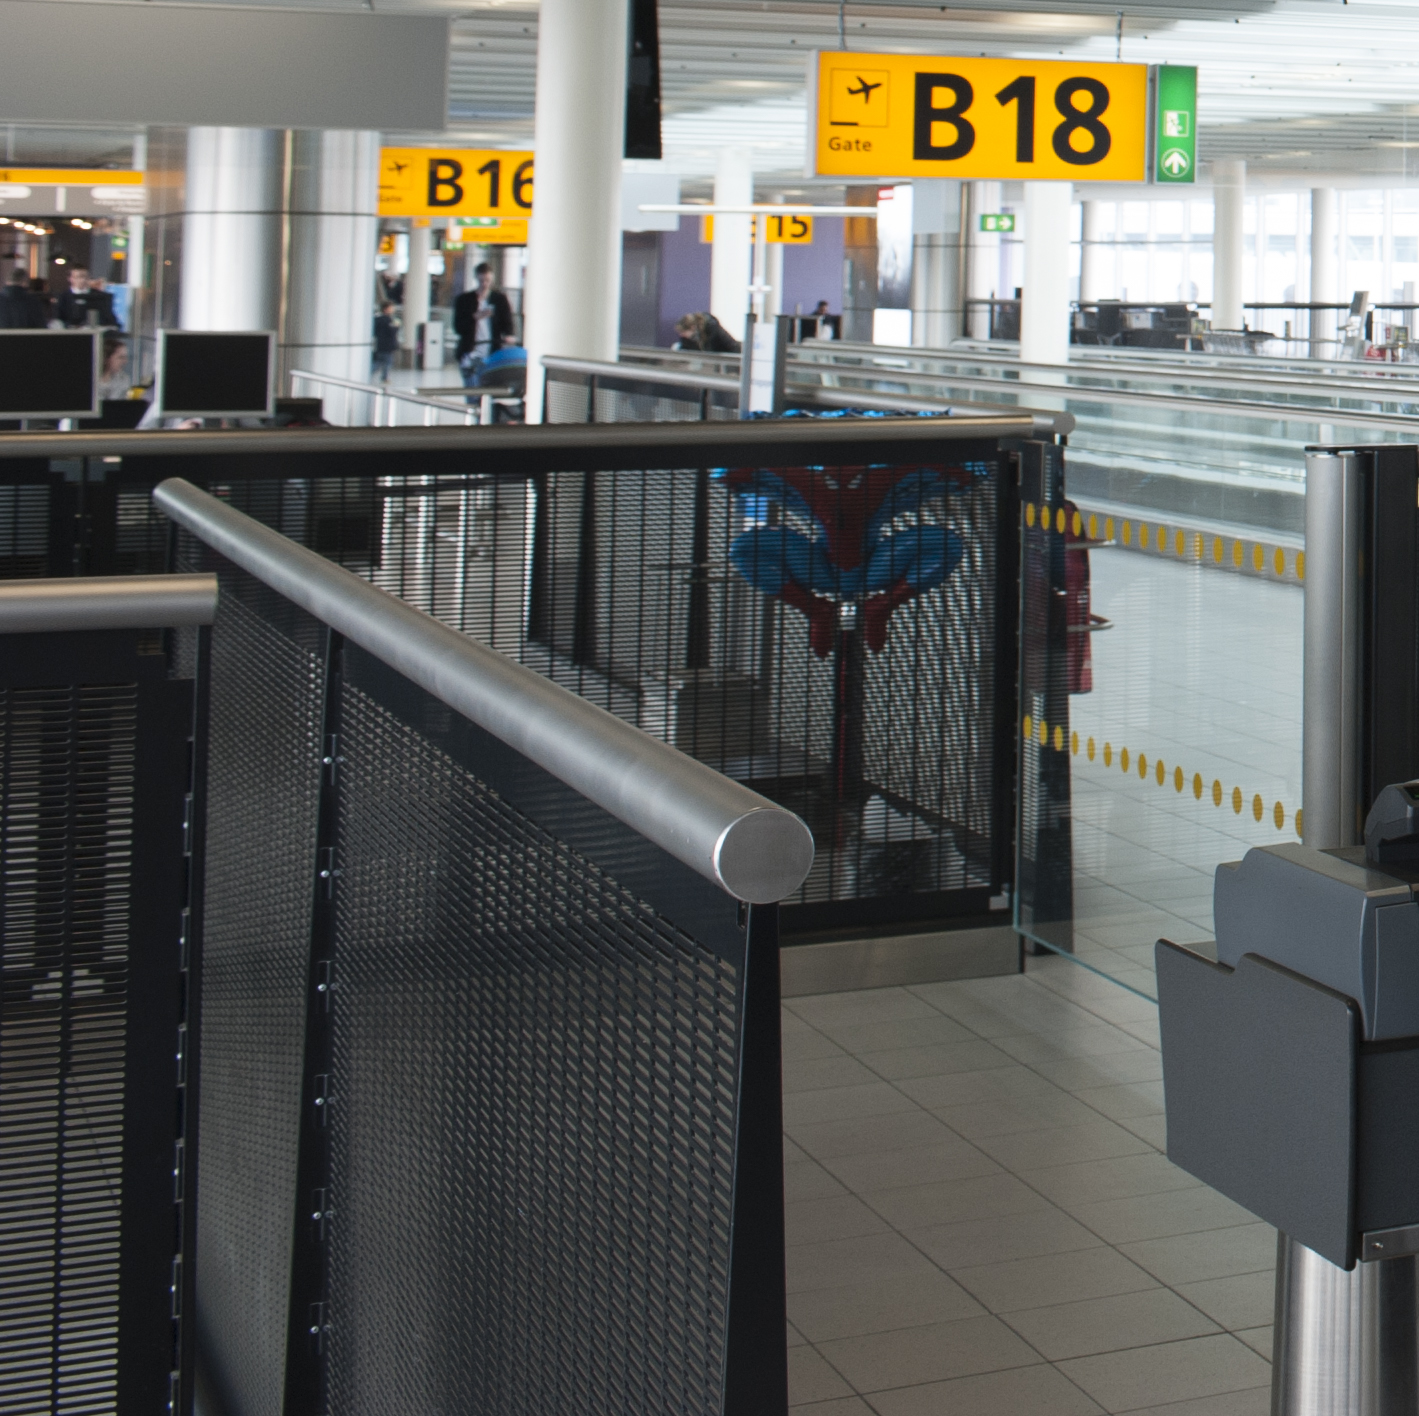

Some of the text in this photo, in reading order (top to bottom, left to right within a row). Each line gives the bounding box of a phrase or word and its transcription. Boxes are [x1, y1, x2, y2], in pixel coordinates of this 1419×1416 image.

[828, 136, 872, 152] Gate
[913, 72, 1111, 166] B18
[428, 158, 534, 209] B16
